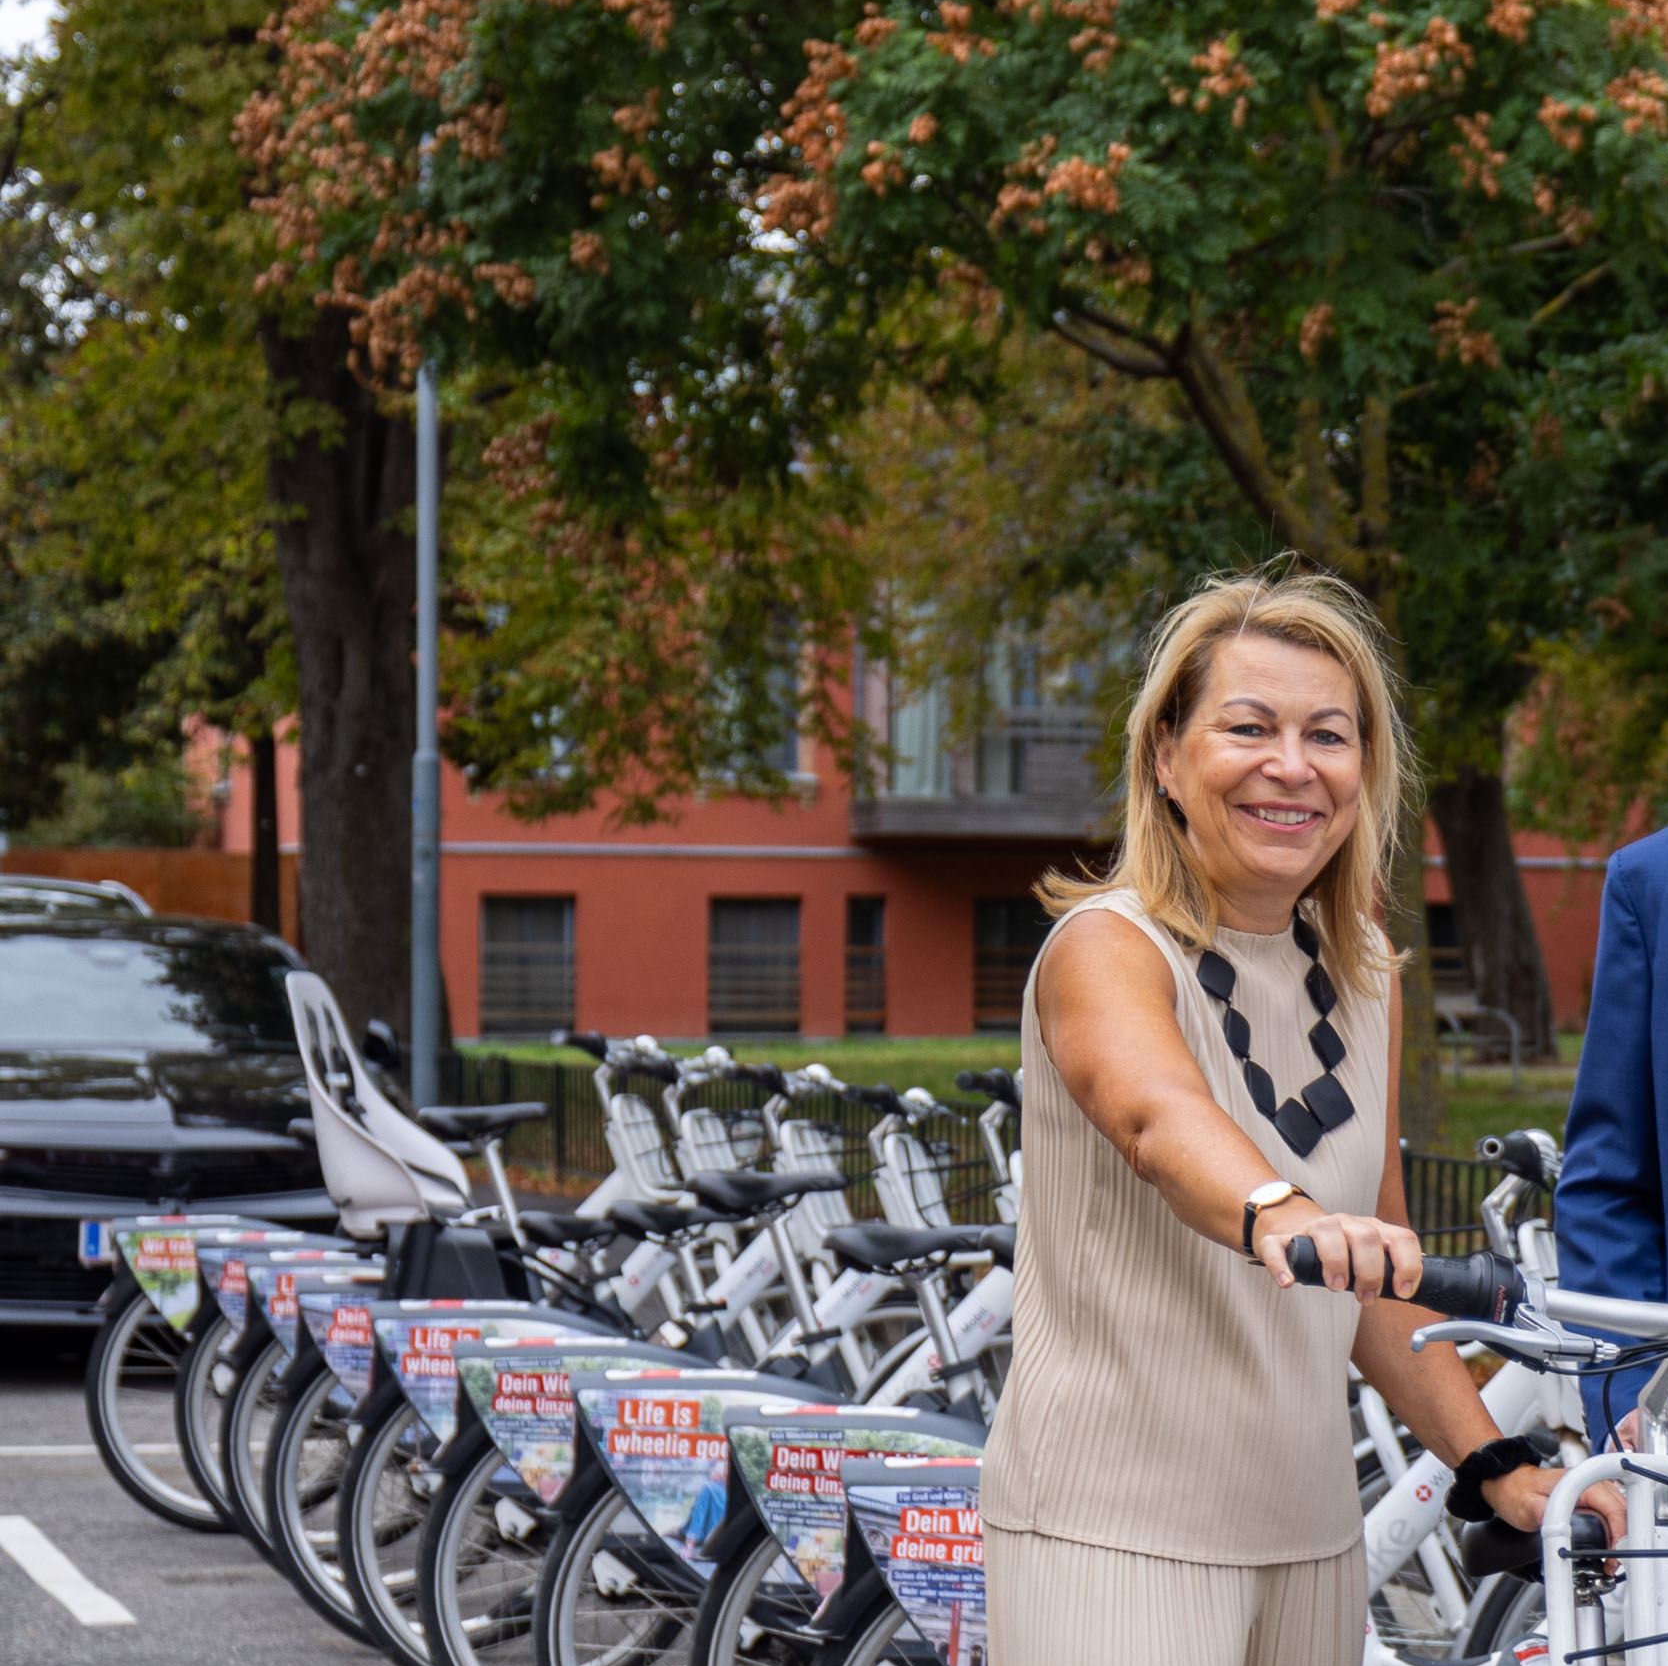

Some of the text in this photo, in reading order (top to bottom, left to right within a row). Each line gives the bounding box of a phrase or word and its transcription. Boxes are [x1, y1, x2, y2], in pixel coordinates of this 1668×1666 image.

[501, 1373, 539, 1393] Dein
[495, 1395, 532, 1412] deine
[623, 1400, 692, 1426] Life is
[614, 1429, 691, 1455] wheelie
[777, 1446, 816, 1470] Dein
[769, 1473, 810, 1492] deine
[905, 1509, 952, 1533] Dein
[896, 1537, 947, 1559] deine
